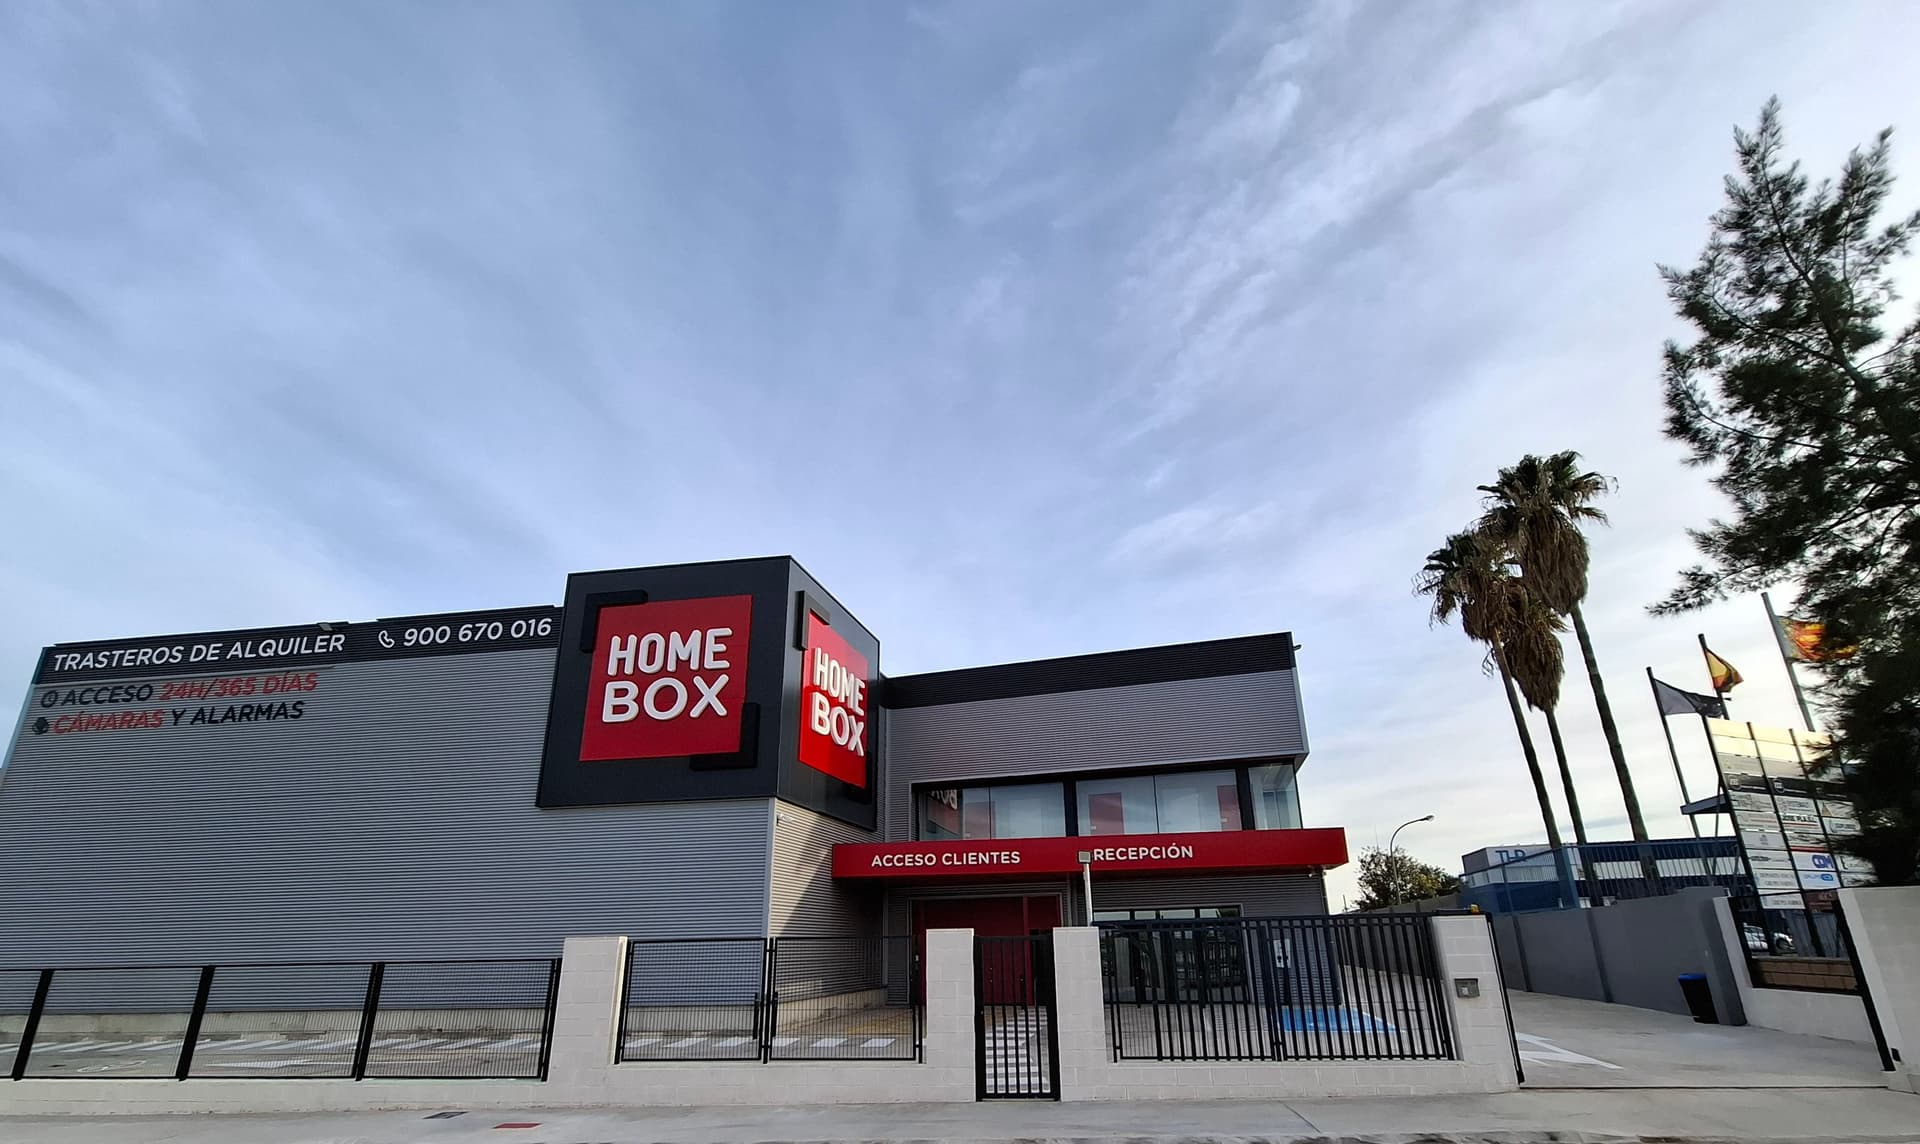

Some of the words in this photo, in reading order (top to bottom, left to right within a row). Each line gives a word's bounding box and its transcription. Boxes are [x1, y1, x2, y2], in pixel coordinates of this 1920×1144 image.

[403, 625, 451, 647] 900
[458, 621, 503, 643] 670
[510, 618, 553, 639] 016
[53, 646, 184, 671] TRASTEROS
[190, 643, 222, 663] DE
[226, 633, 346, 660] ALQUILER
[607, 627, 733, 676] HOME
[61, 683, 154, 707] ACCESO
[159, 677, 257, 701] 24H/365
[262, 671, 318, 695] DÍAS
[602, 673, 730, 723] BOX
[812, 647, 865, 717] HOME
[53, 708, 165, 734] CÁMARAS
[171, 708, 187, 726] Y
[190, 700, 305, 726] ALARMAS
[811, 691, 865, 757] BOX
[871, 853, 937, 867] ACCESO
[942, 850, 1020, 866] CLIENTES
[1092, 842, 1194, 861] RECEPCIÓN
